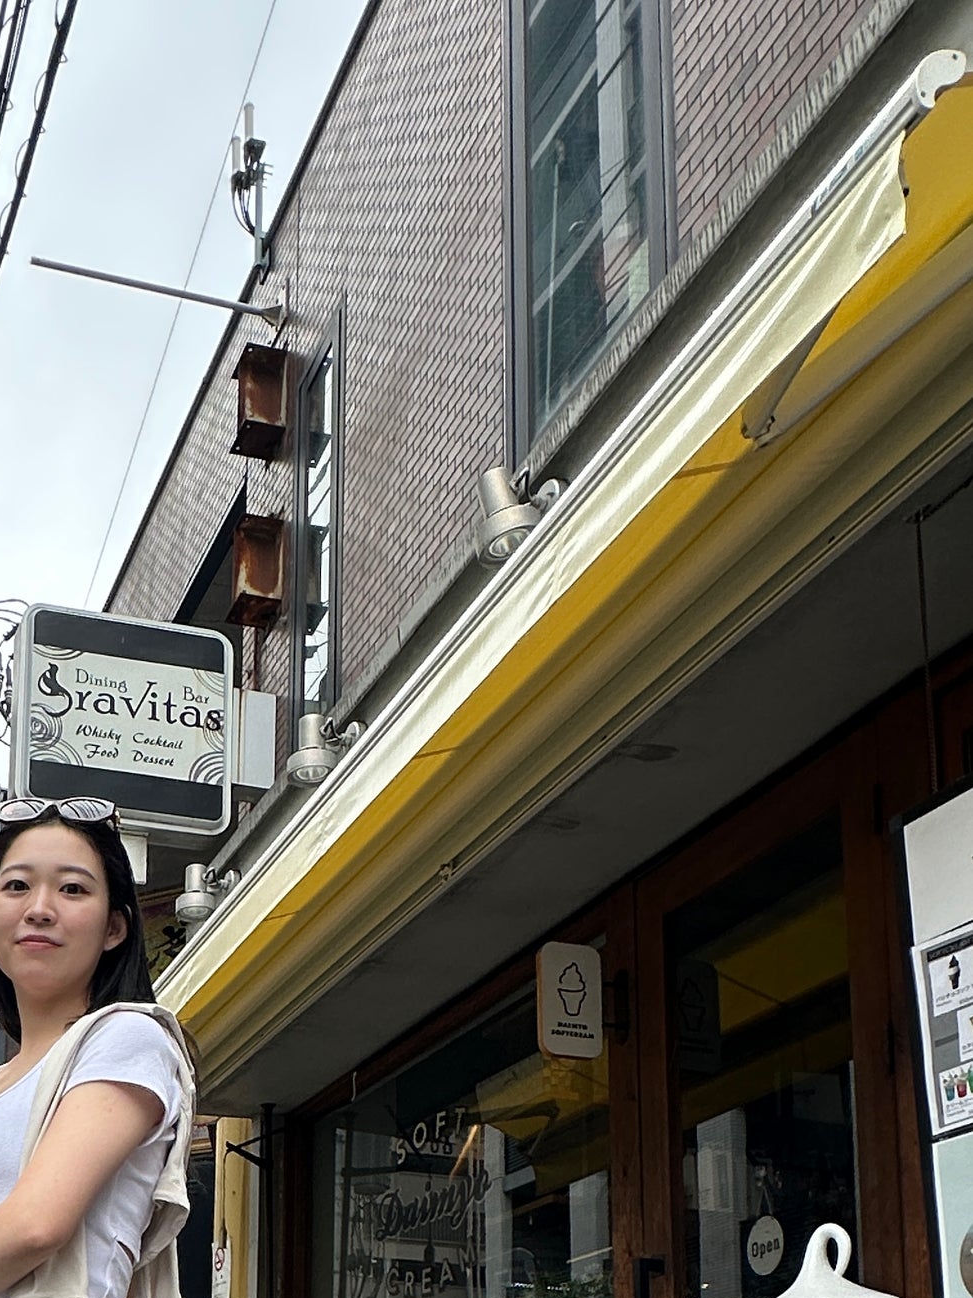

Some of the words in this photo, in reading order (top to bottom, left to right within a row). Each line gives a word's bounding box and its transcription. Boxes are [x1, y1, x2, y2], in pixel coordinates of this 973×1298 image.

[75, 668, 128, 693] Dining
[183, 686, 210, 705] Bar
[76, 723, 122, 743] Whisky
[132, 732, 183, 750] Cocktail
[84, 743, 119, 760] Food
[131, 750, 175, 767] Dessert
[395, 1107, 467, 1165] SOFT
[752, 1238, 780, 1259] Open
[386, 1245, 478, 1298] CREAM
